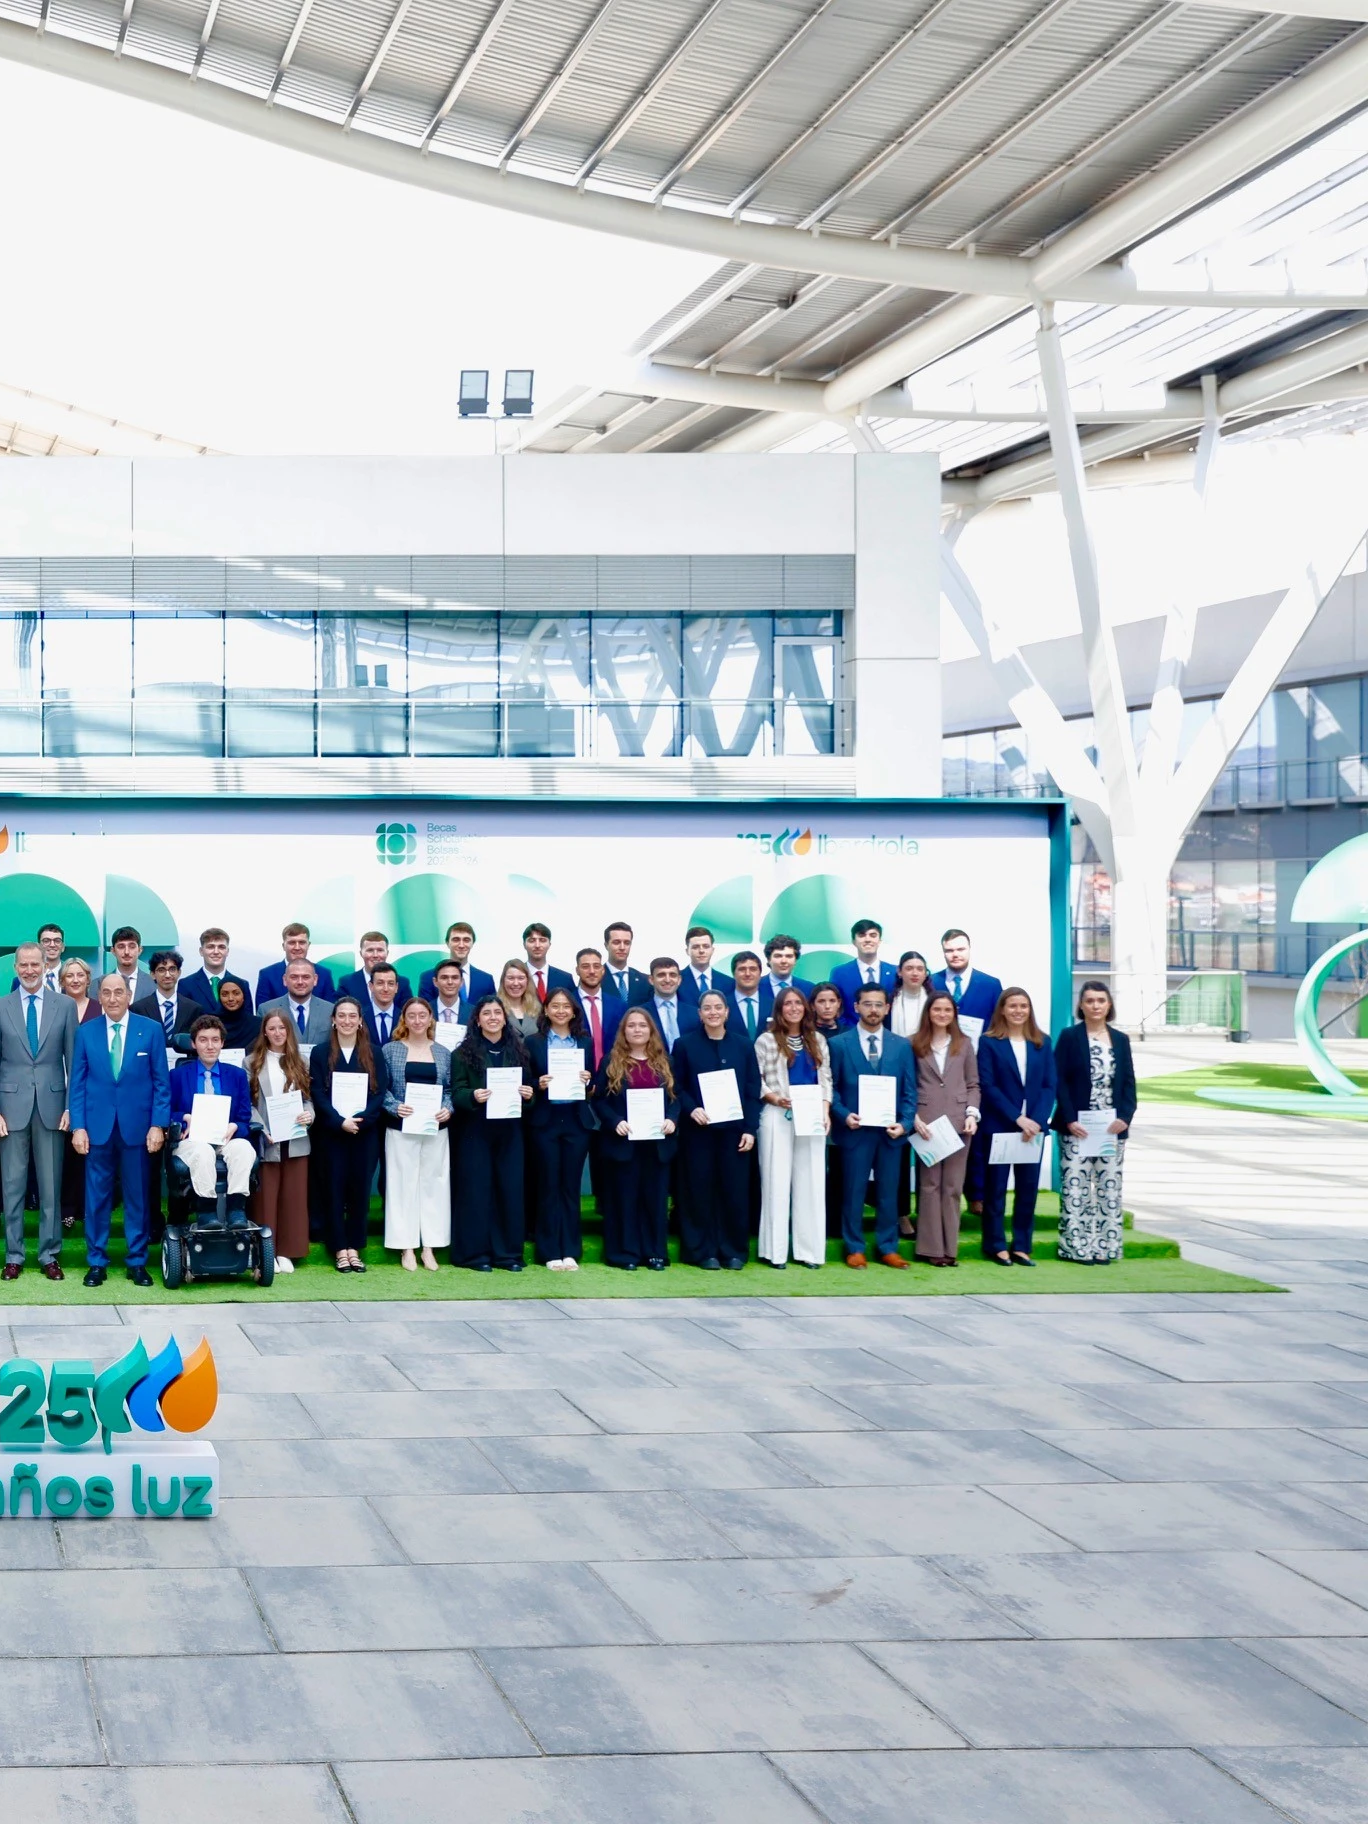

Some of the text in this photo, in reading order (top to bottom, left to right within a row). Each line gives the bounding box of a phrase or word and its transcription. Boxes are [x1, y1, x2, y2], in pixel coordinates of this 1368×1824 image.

[427, 822, 457, 833] Becas
[427, 845, 459, 855] Bolsas
[132, 1463, 213, 1516] luz
